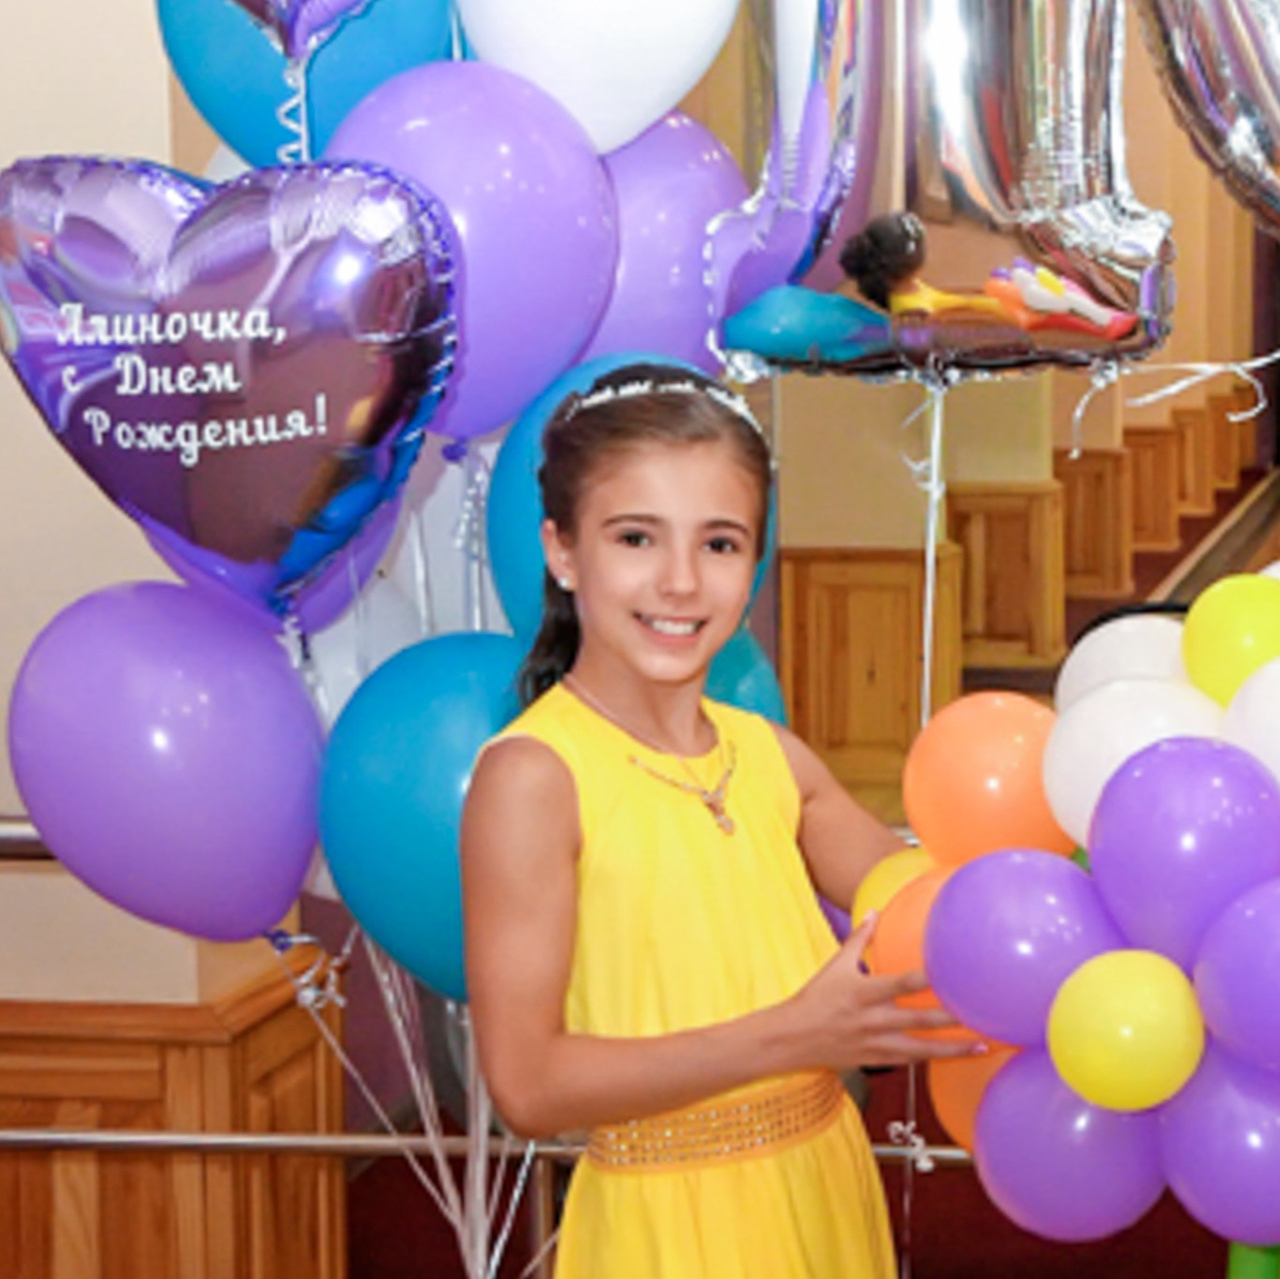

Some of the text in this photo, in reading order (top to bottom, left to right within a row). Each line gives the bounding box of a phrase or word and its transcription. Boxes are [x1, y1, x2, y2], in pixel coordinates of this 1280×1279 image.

[56, 302, 287, 345] Алиночка,
[62, 352, 242, 395] с Днем
[83, 393, 327, 467] Рождения!
